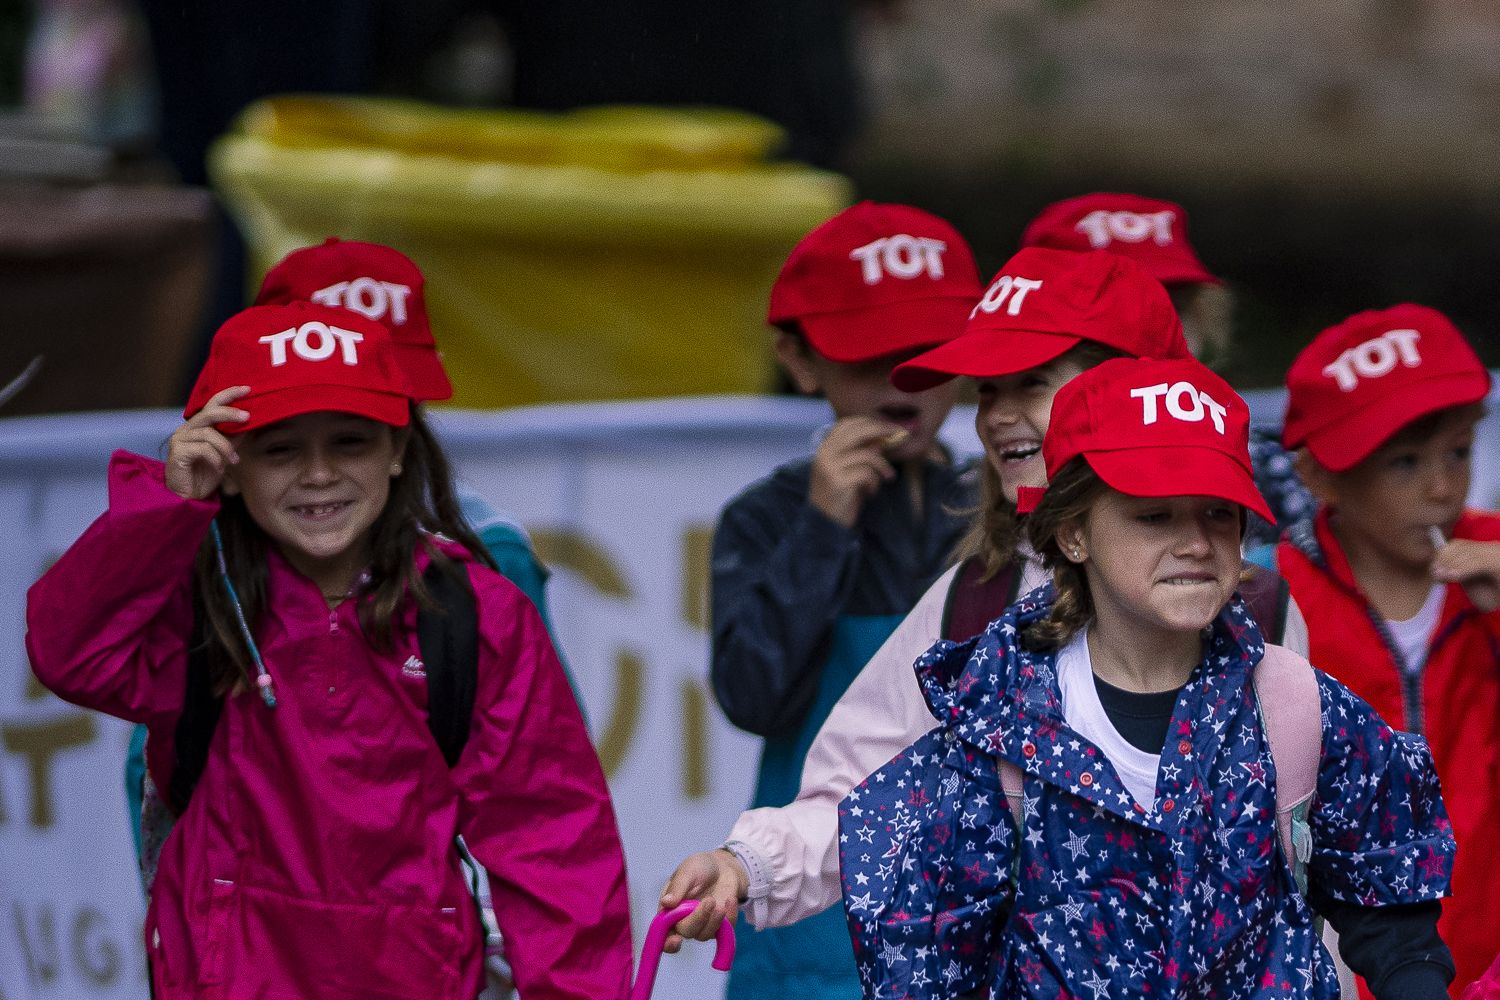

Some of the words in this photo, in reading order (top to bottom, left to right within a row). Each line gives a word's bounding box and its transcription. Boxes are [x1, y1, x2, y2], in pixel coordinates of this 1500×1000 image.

[1075, 210, 1176, 249] TOT
[849, 233, 947, 286] TOT
[311, 276, 411, 325] TOT
[968, 275, 1044, 321] OT
[258, 321, 364, 367] TOT
[1322, 329, 1422, 393] TOT
[1129, 381, 1228, 436] TOT
